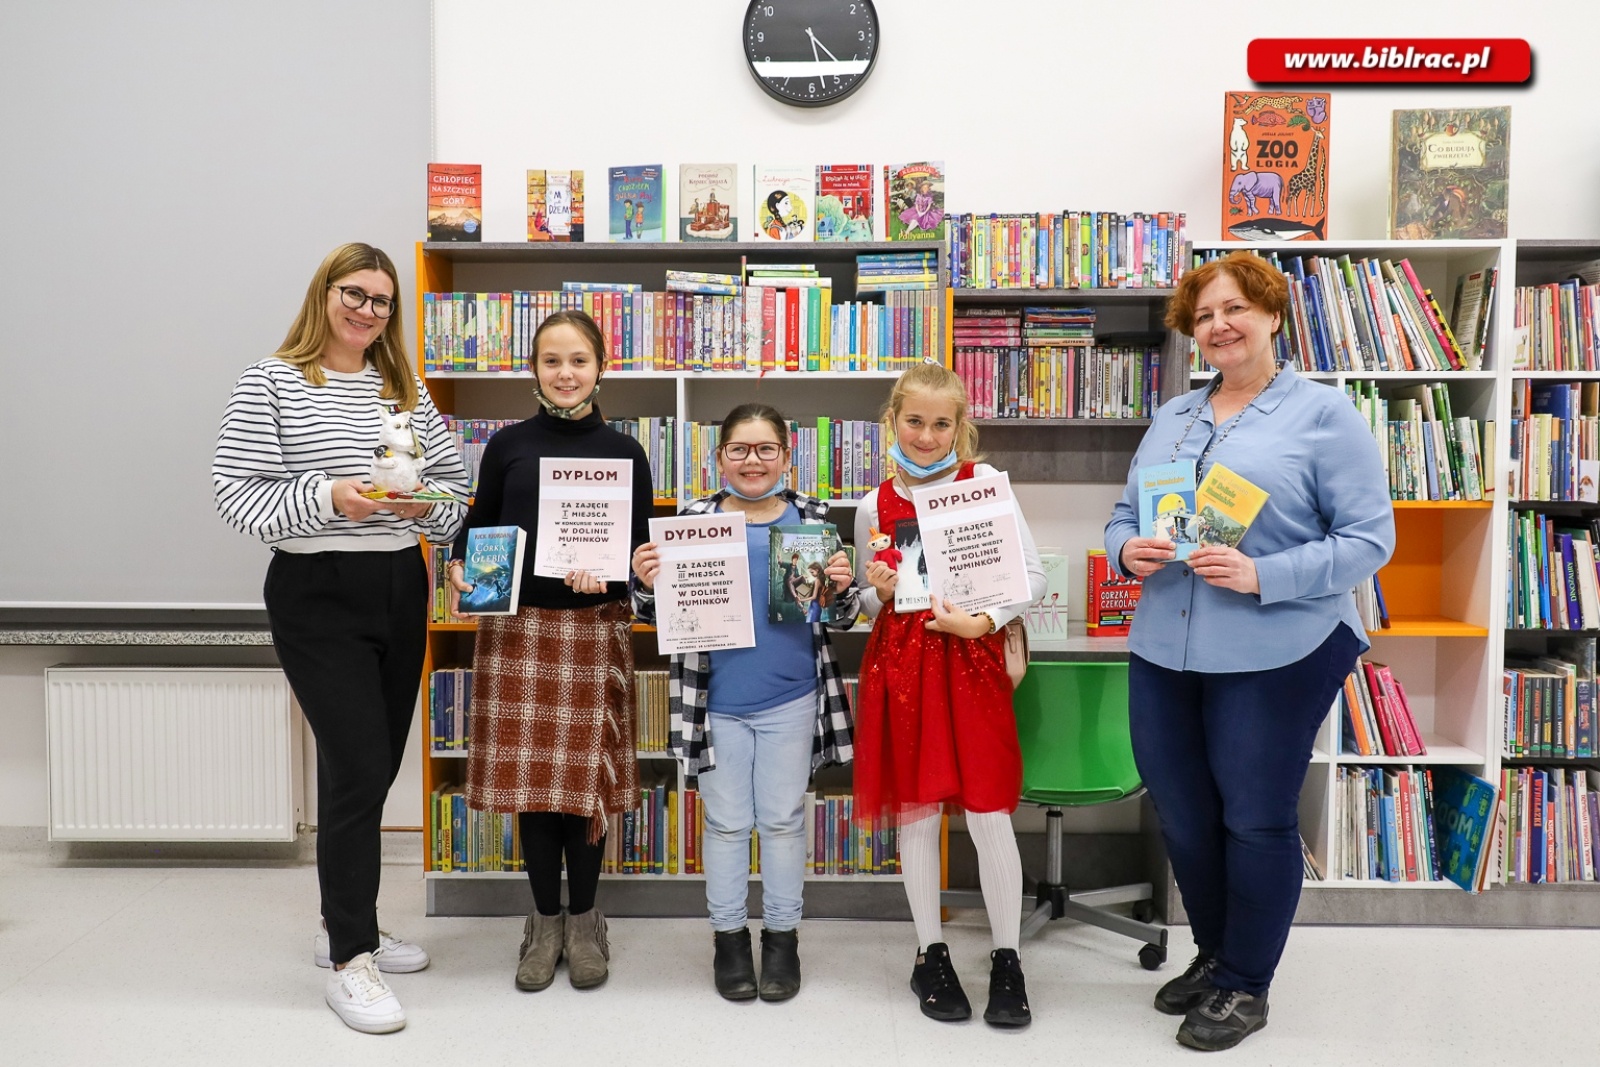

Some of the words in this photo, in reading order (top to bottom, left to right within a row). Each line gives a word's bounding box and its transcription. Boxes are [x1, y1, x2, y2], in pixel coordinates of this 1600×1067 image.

[763, 5, 774, 17] 10
[849, 3, 856, 15] 2
[757, 31, 764, 42] 9
[857, 30, 865, 41] 3
[833, 75, 841, 84] 5
[808, 82, 816, 93] 6
[1256, 140, 1298, 159] ZOO
[1256, 160, 1298, 168] LOGIA
[901, 166, 934, 175] KLASYKA
[433, 175, 475, 184] CHŁOPIEC
[443, 186, 476, 195] SZCZYCIE
[553, 191, 562, 199] M
[442, 196, 466, 205] GÓRY
[898, 230, 935, 242] Pollyanna
[552, 470, 618, 481] DYPLOM
[928, 487, 997, 510] DYPLOM
[575, 502, 609, 510] ZAJĘCIE
[664, 526, 732, 541] DYPLOM
[944, 528, 955, 536] ZA
[958, 520, 994, 534] ZAJĘCIE
[558, 535, 609, 543] MUMINKÓW
[956, 531, 994, 543] MIEJSCA
[475, 543, 506, 552] CÓRKA
[949, 544, 980, 554] KONKURSIE
[981, 539, 1003, 547] WIEDZY
[949, 555, 957, 563] W
[961, 547, 999, 560] DOLINIE
[691, 560, 726, 569] ZAJĘCIE
[949, 556, 1002, 573] MUMINKÓW
[688, 570, 725, 578] MIEJSCA
[1567, 561, 1577, 602] DINOZAURY
[691, 588, 728, 596] DOLINIE
[1100, 590, 1129, 600] GORZKA
[677, 596, 730, 607] MUMINKÓW
[905, 596, 928, 604] MIASTO
[1534, 778, 1542, 827] WYNALAZKI
